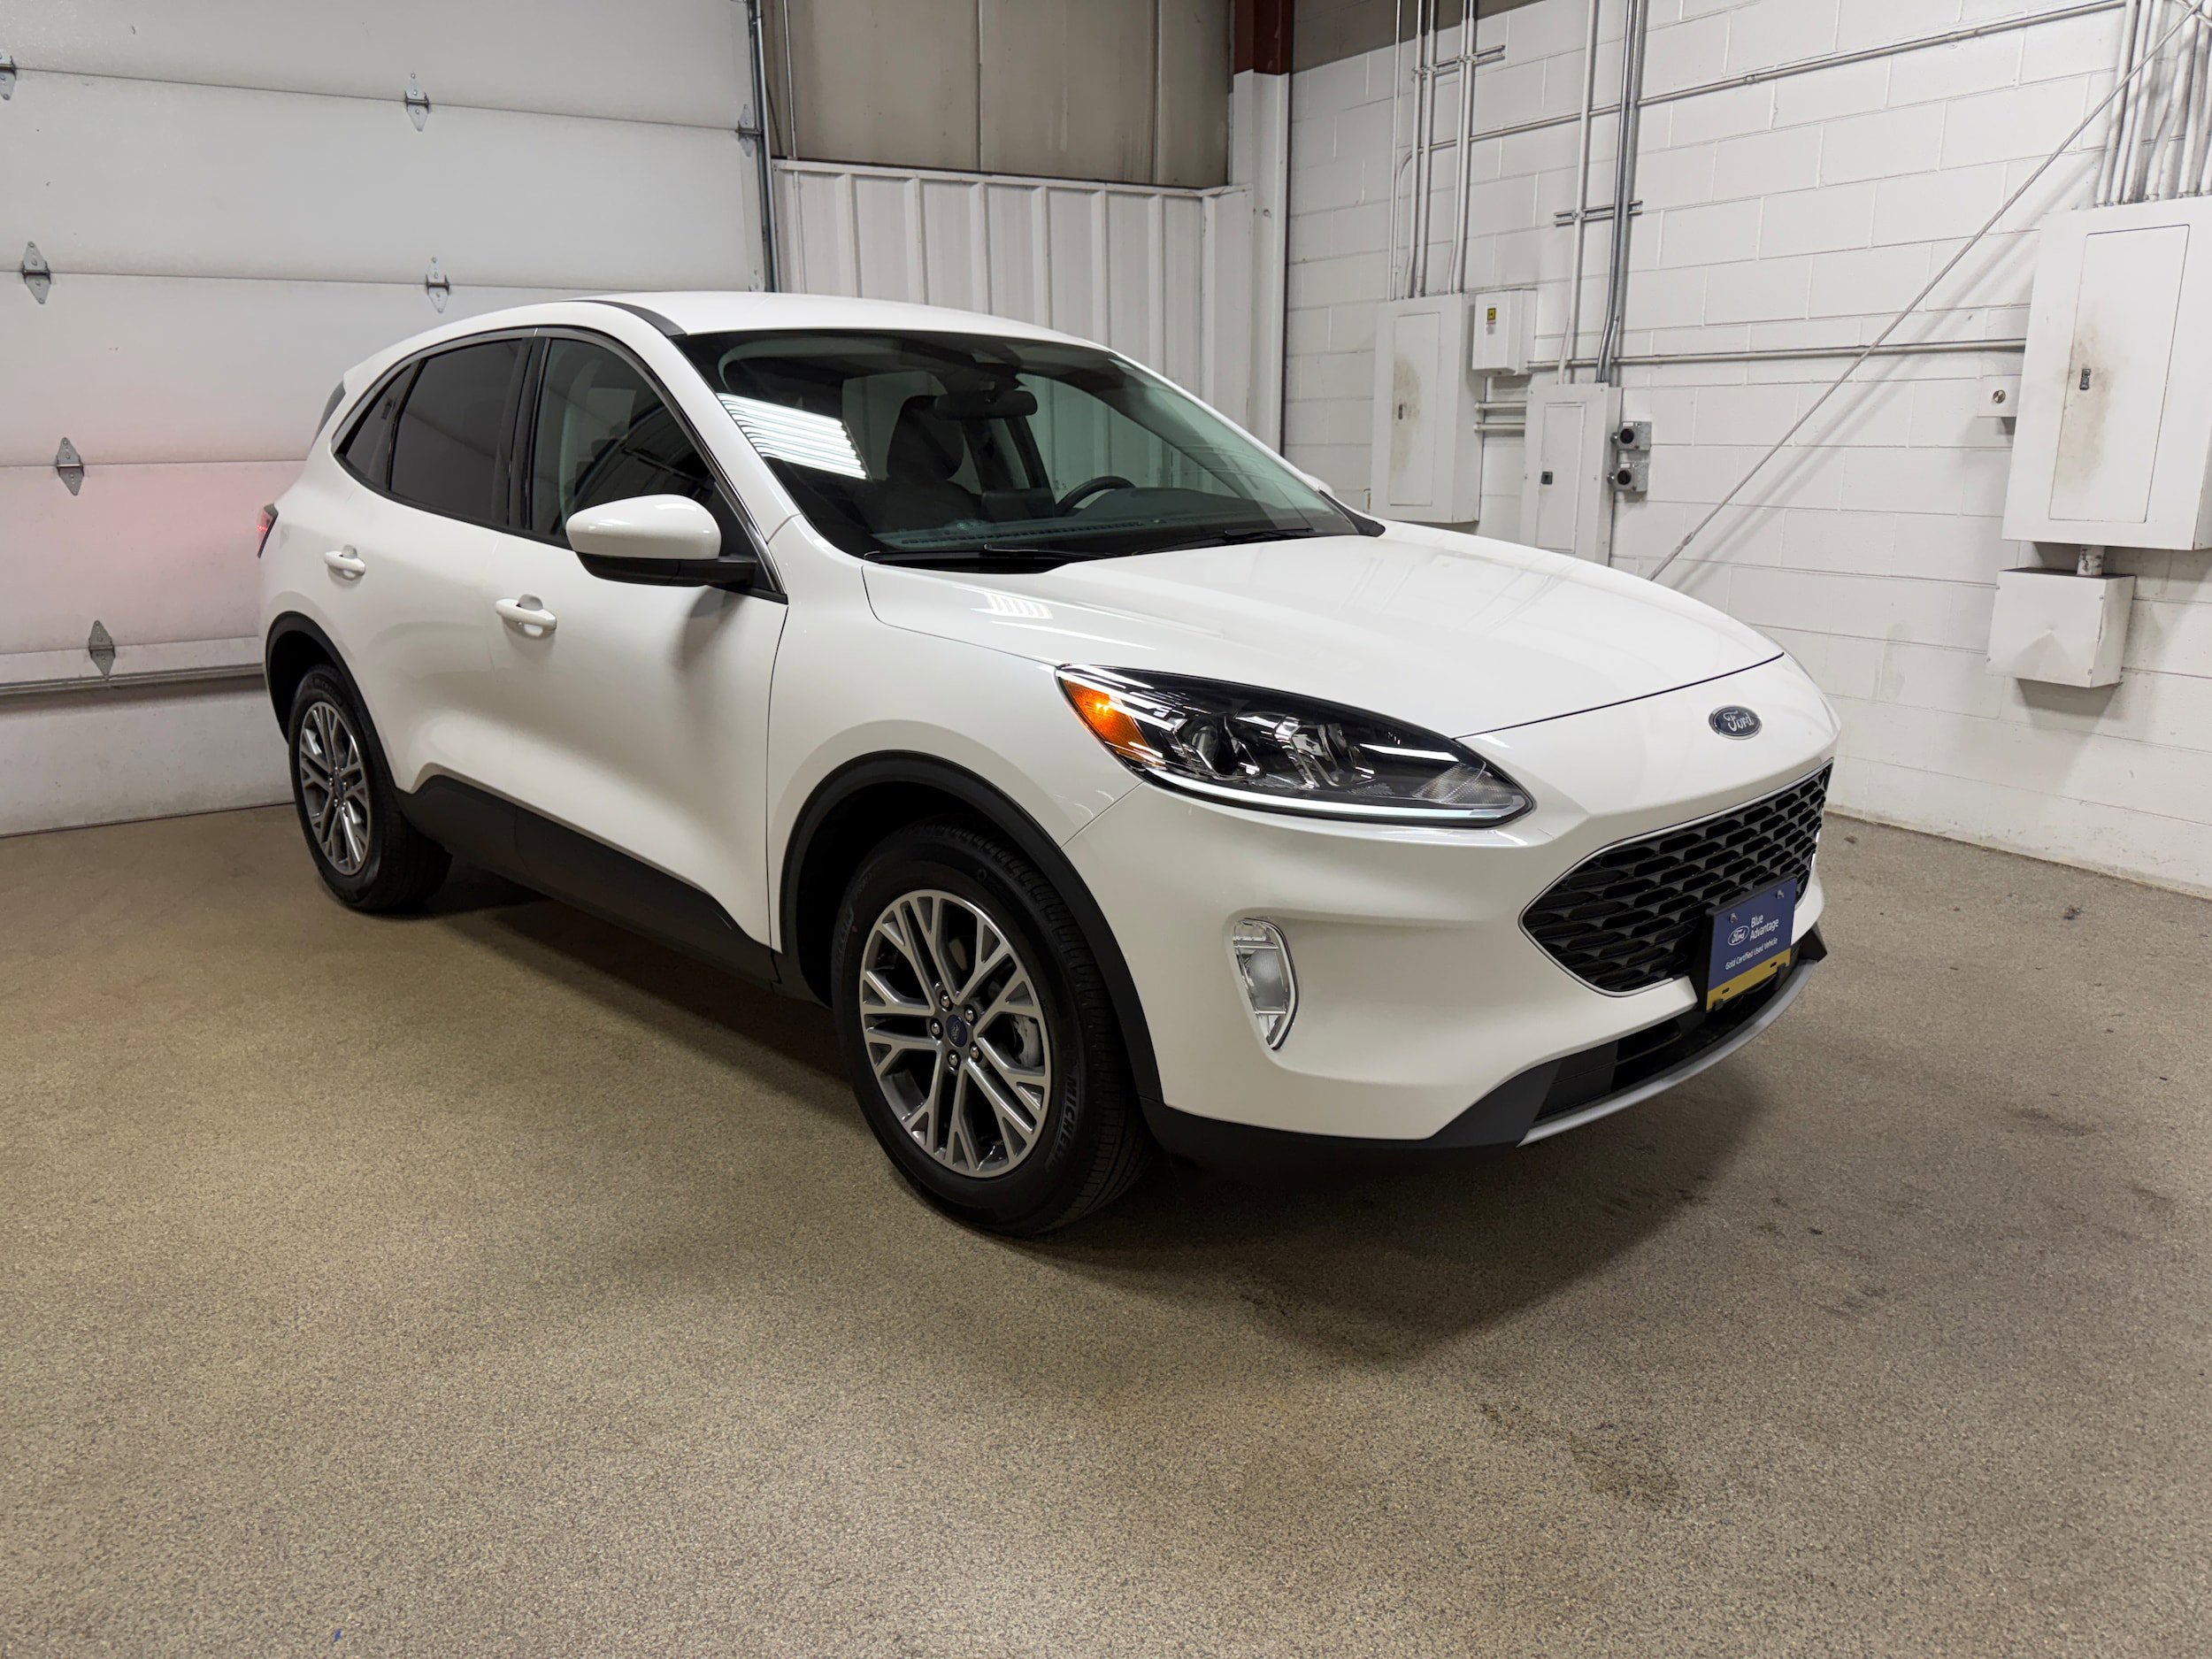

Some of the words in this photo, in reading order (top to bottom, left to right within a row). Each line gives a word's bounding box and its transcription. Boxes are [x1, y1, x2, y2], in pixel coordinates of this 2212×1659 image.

[1723, 710, 1755, 732] Ford
[1749, 918, 1779, 941] Advantage
[1750, 914, 1764, 928] Blue
[1725, 958, 1736, 971] Gold
[1736, 950, 1754, 964] Certified
[1753, 943, 1764, 956] Used
[1763, 937, 1778, 949] Vehicle
